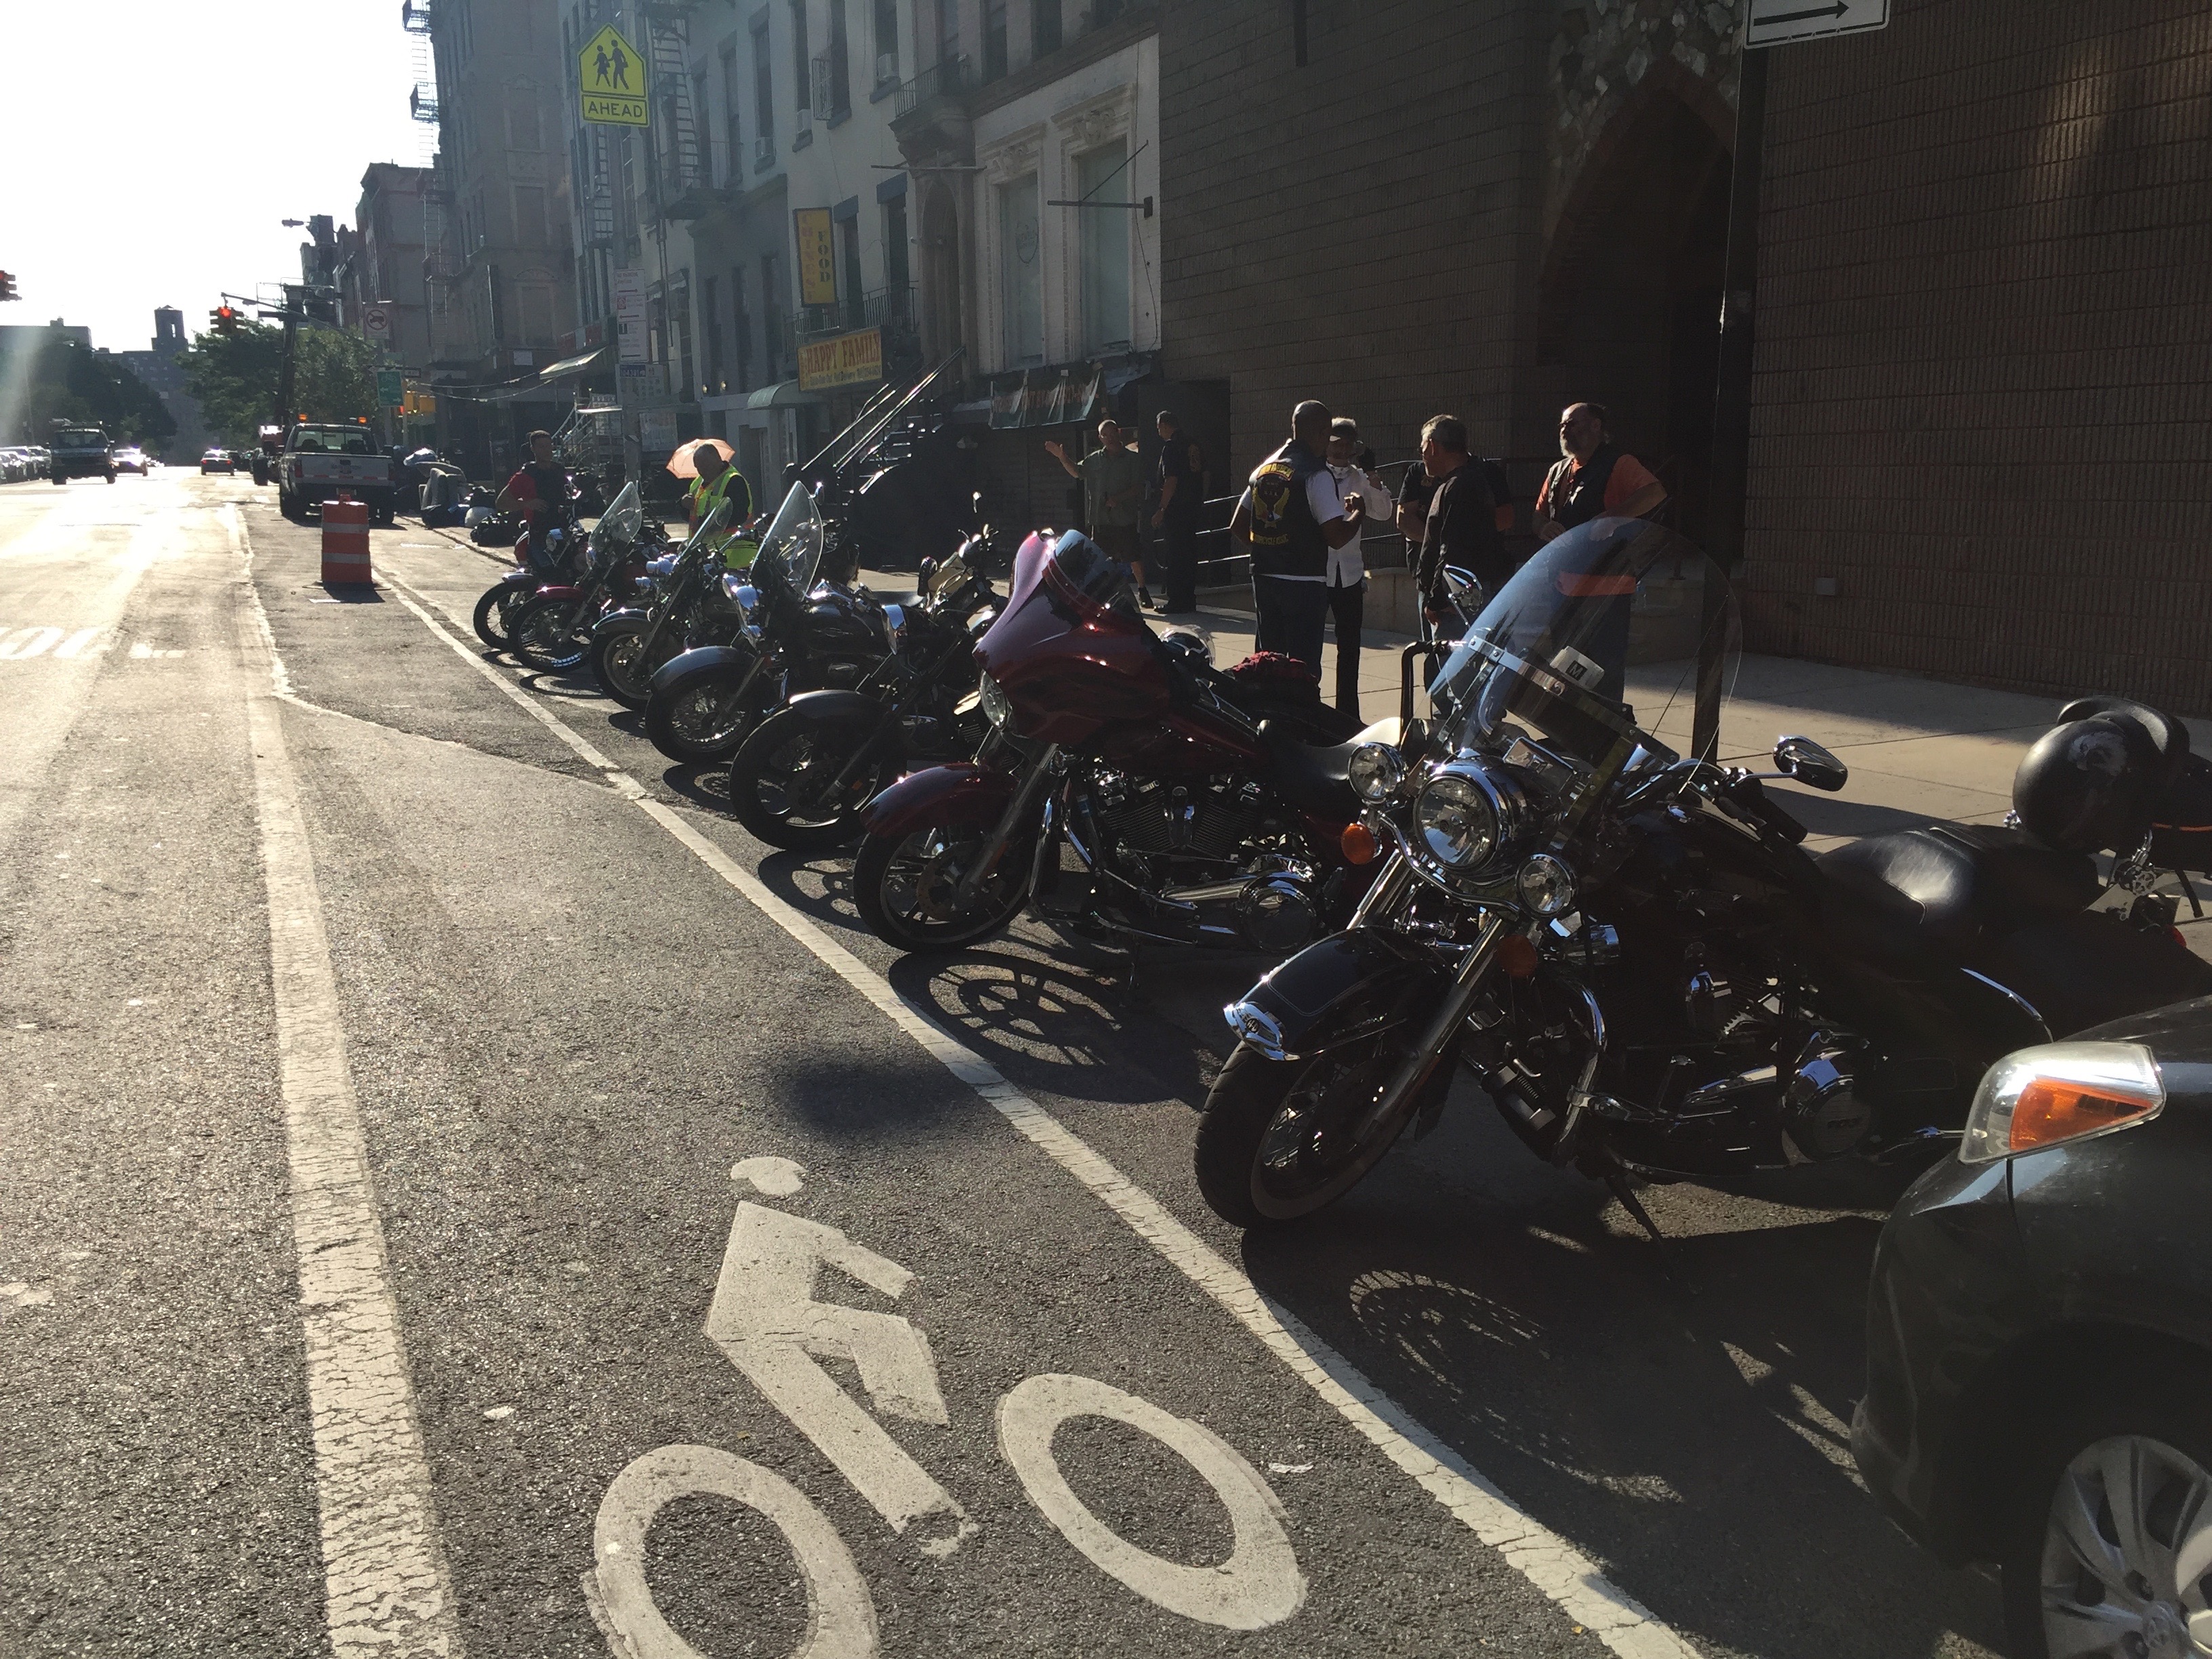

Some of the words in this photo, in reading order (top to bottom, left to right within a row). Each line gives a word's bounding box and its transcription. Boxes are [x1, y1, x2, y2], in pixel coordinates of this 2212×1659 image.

[588, 100, 643, 118] AHEAD
[817, 230, 831, 283] FOOD
[806, 342, 838, 373] HAPPY
[841, 332, 881, 368] FAMILY
[1569, 663, 1584, 679] M
